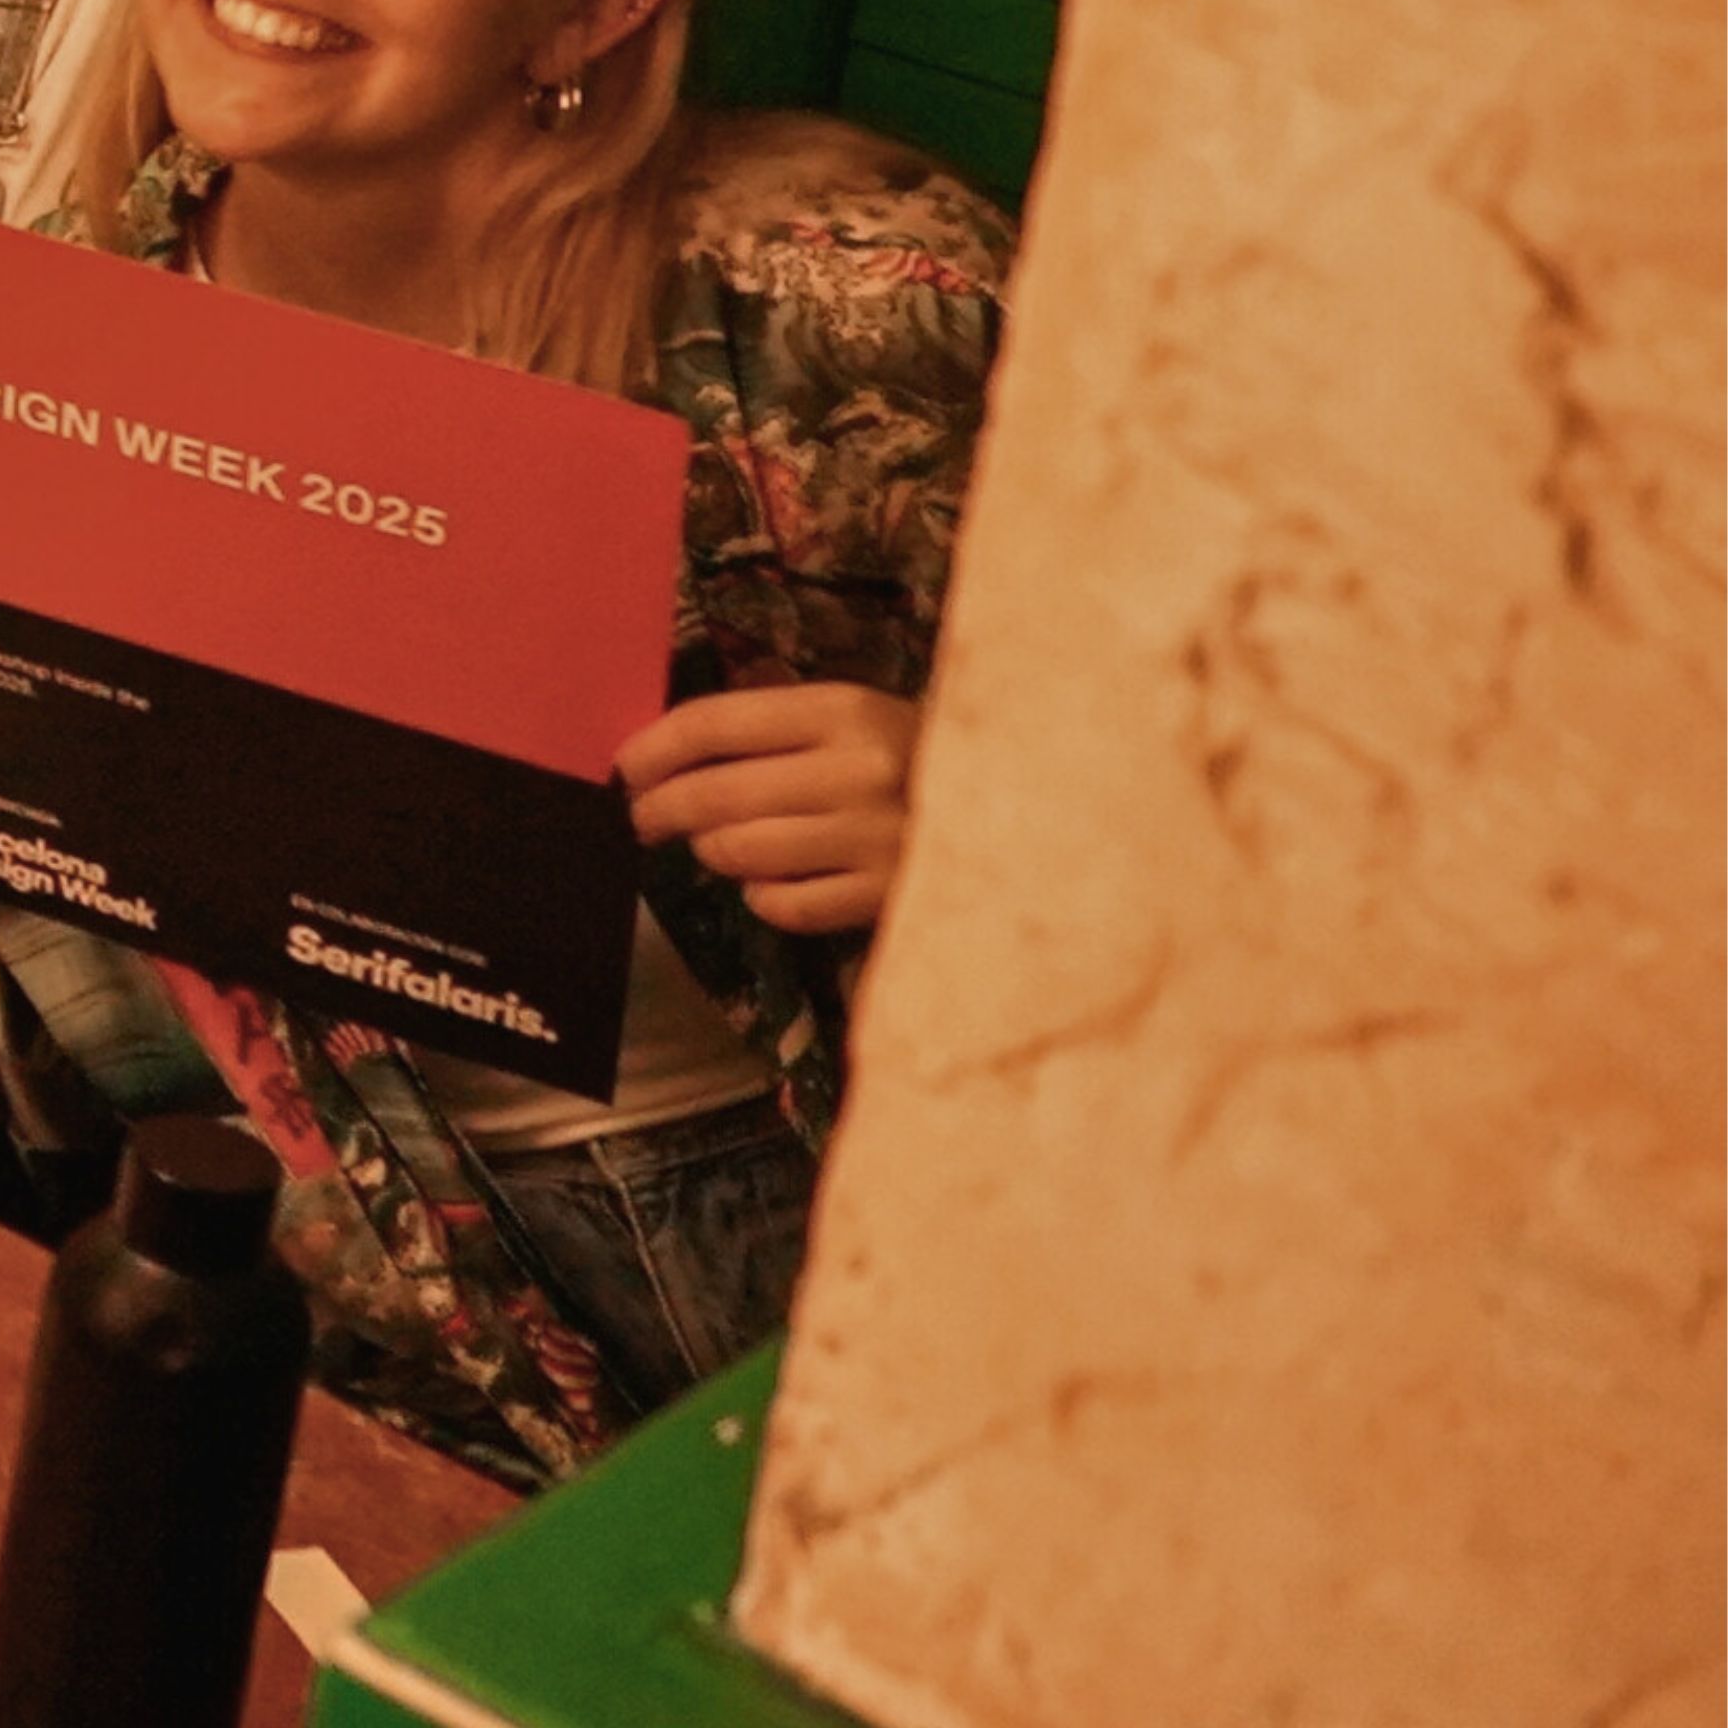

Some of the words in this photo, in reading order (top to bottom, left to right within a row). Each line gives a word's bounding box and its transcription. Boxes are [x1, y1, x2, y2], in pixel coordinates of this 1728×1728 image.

[114, 417, 285, 501] WEEK
[299, 473, 447, 546] 2025
[286, 925, 558, 1043] Serifalaris.
